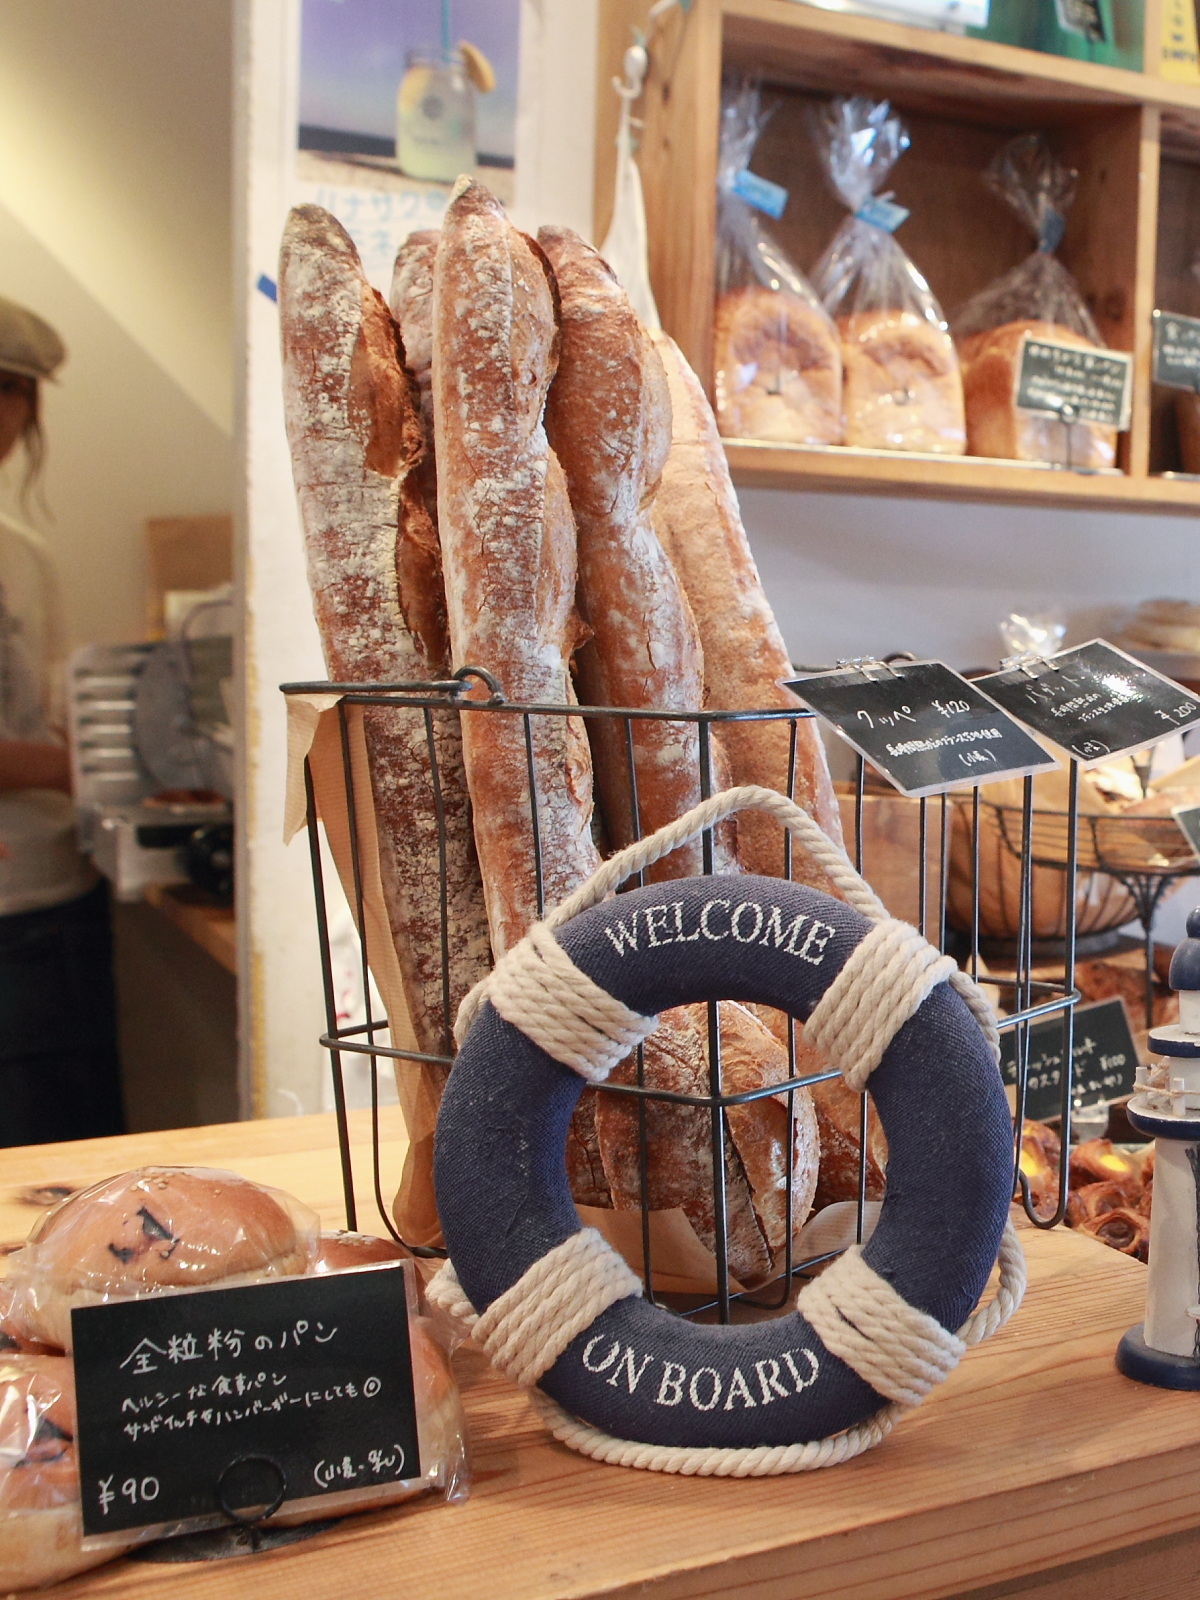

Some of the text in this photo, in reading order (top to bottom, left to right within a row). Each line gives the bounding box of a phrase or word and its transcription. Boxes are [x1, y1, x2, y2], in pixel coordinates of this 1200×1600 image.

[857, 699, 971, 729] クッペ ¥120
[604, 899, 836, 966] WELCOME
[119, 1320, 338, 1375] 全粒粉のパン
[121, 1371, 287, 1414] ヘルシーな食事パン
[582, 1334, 821, 1411] ON BOARD
[97, 1474, 160, 1515] ¥90
